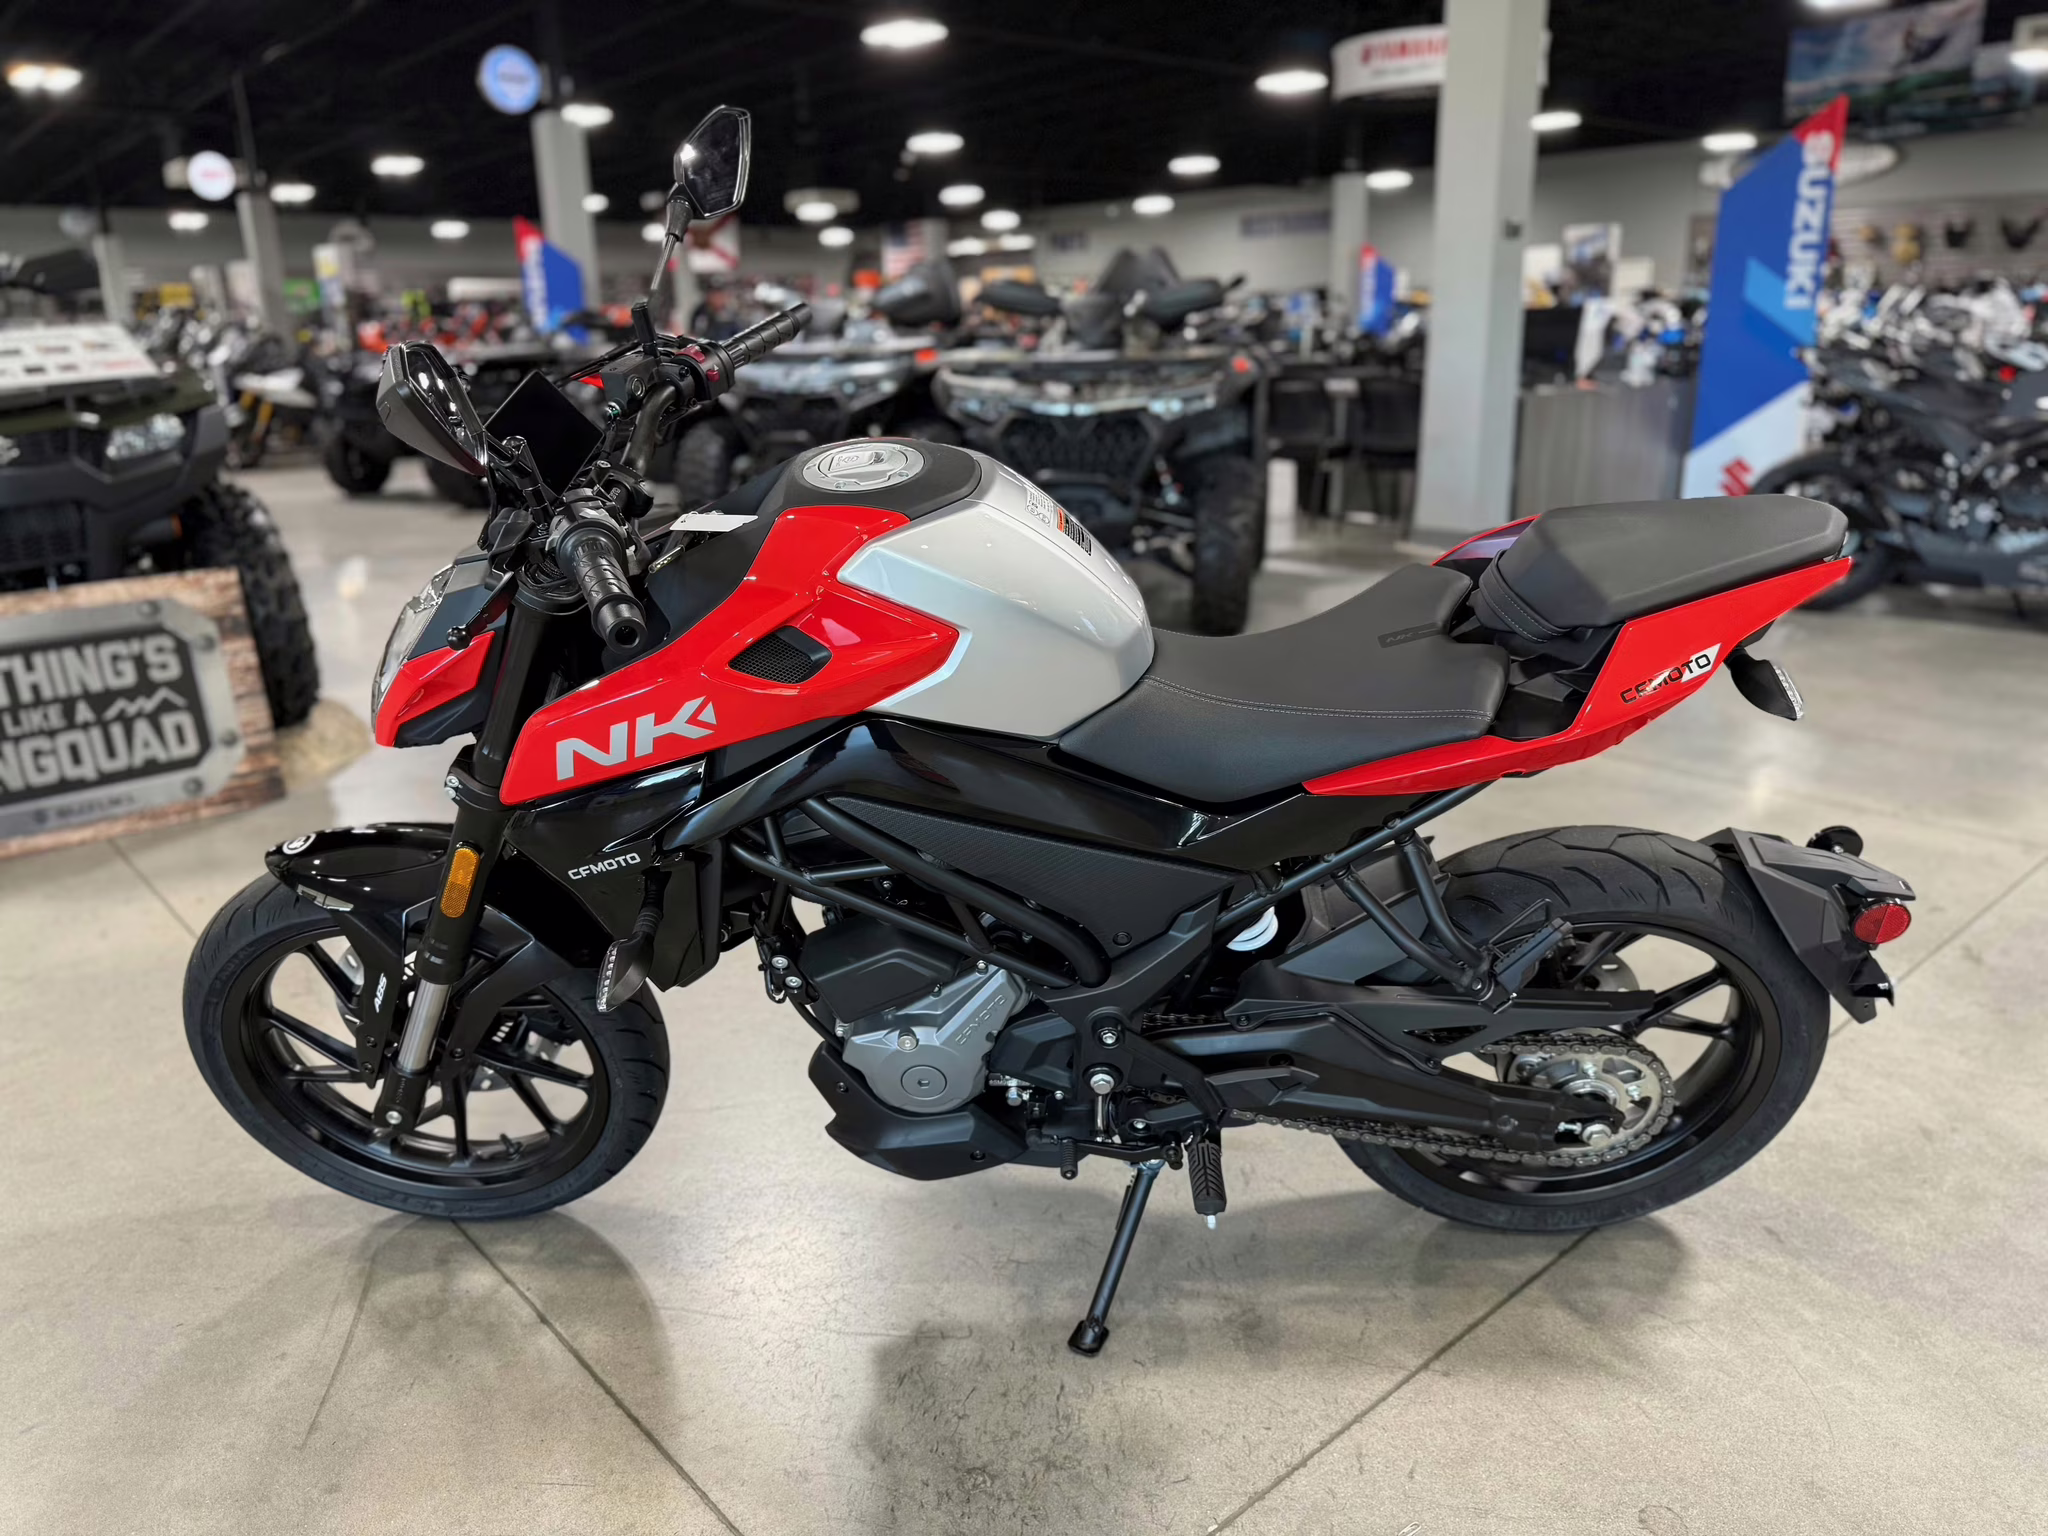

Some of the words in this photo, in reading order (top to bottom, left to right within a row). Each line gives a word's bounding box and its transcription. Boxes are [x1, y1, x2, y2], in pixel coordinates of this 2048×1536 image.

[1784, 130, 1835, 309] SUZUKI
[1619, 652, 1712, 705] CFMOTO
[2, 703, 67, 737] LIKE
[75, 699, 96, 725] A
[555, 695, 717, 781] NK
[567, 852, 641, 880] CFMOTO
[373, 972, 388, 1014] ABS
[955, 994, 1006, 1045] CFMOTO
